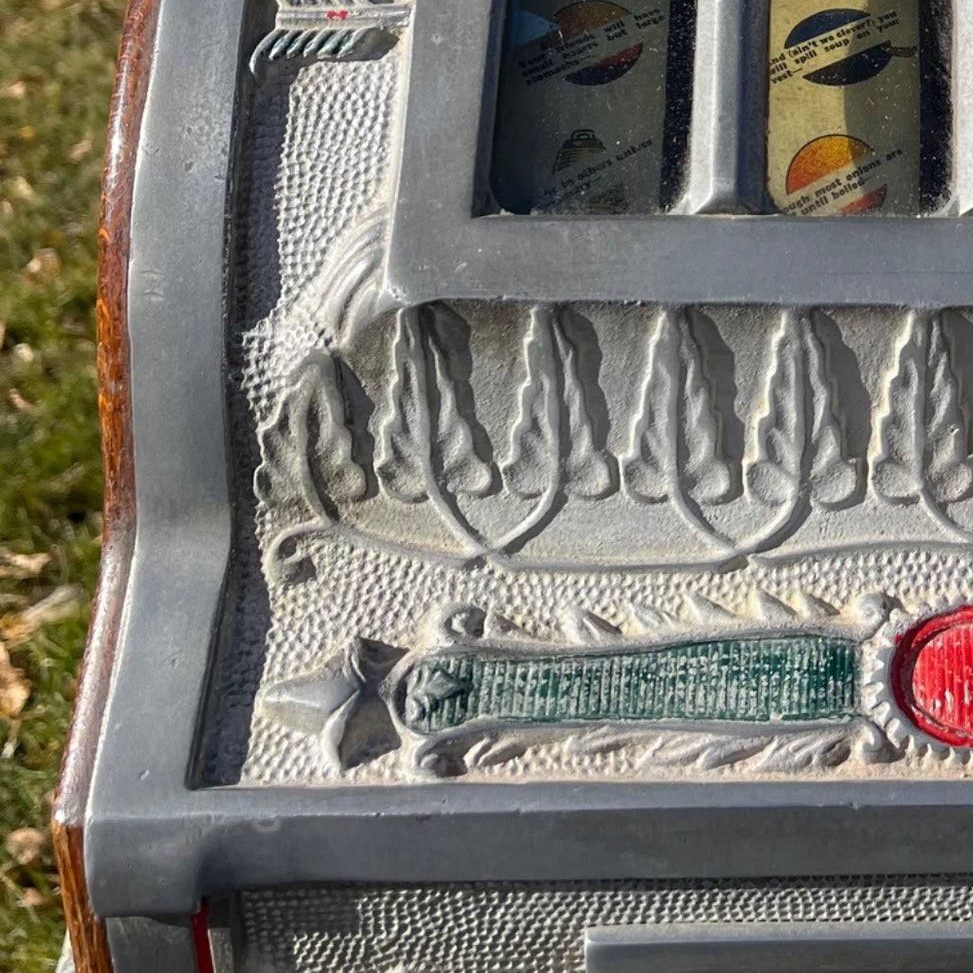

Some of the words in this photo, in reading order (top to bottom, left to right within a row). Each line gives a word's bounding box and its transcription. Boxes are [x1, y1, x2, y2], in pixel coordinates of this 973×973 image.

[603, 19, 626, 34] will
[633, 8, 661, 22] have
[792, 49, 818, 66] spill
[823, 36, 850, 54] soup
[855, 29, 871, 40] on
[876, 17, 901, 35] your
[819, 34, 836, 46] we
[877, 10, 898, 22] you
[520, 58, 554, 77] small
[605, 27, 629, 41] but
[635, 14, 666, 31] large
[814, 178, 843, 199] most
[845, 158, 883, 182] onions
[884, 147, 905, 163] are
[800, 196, 830, 216] until
